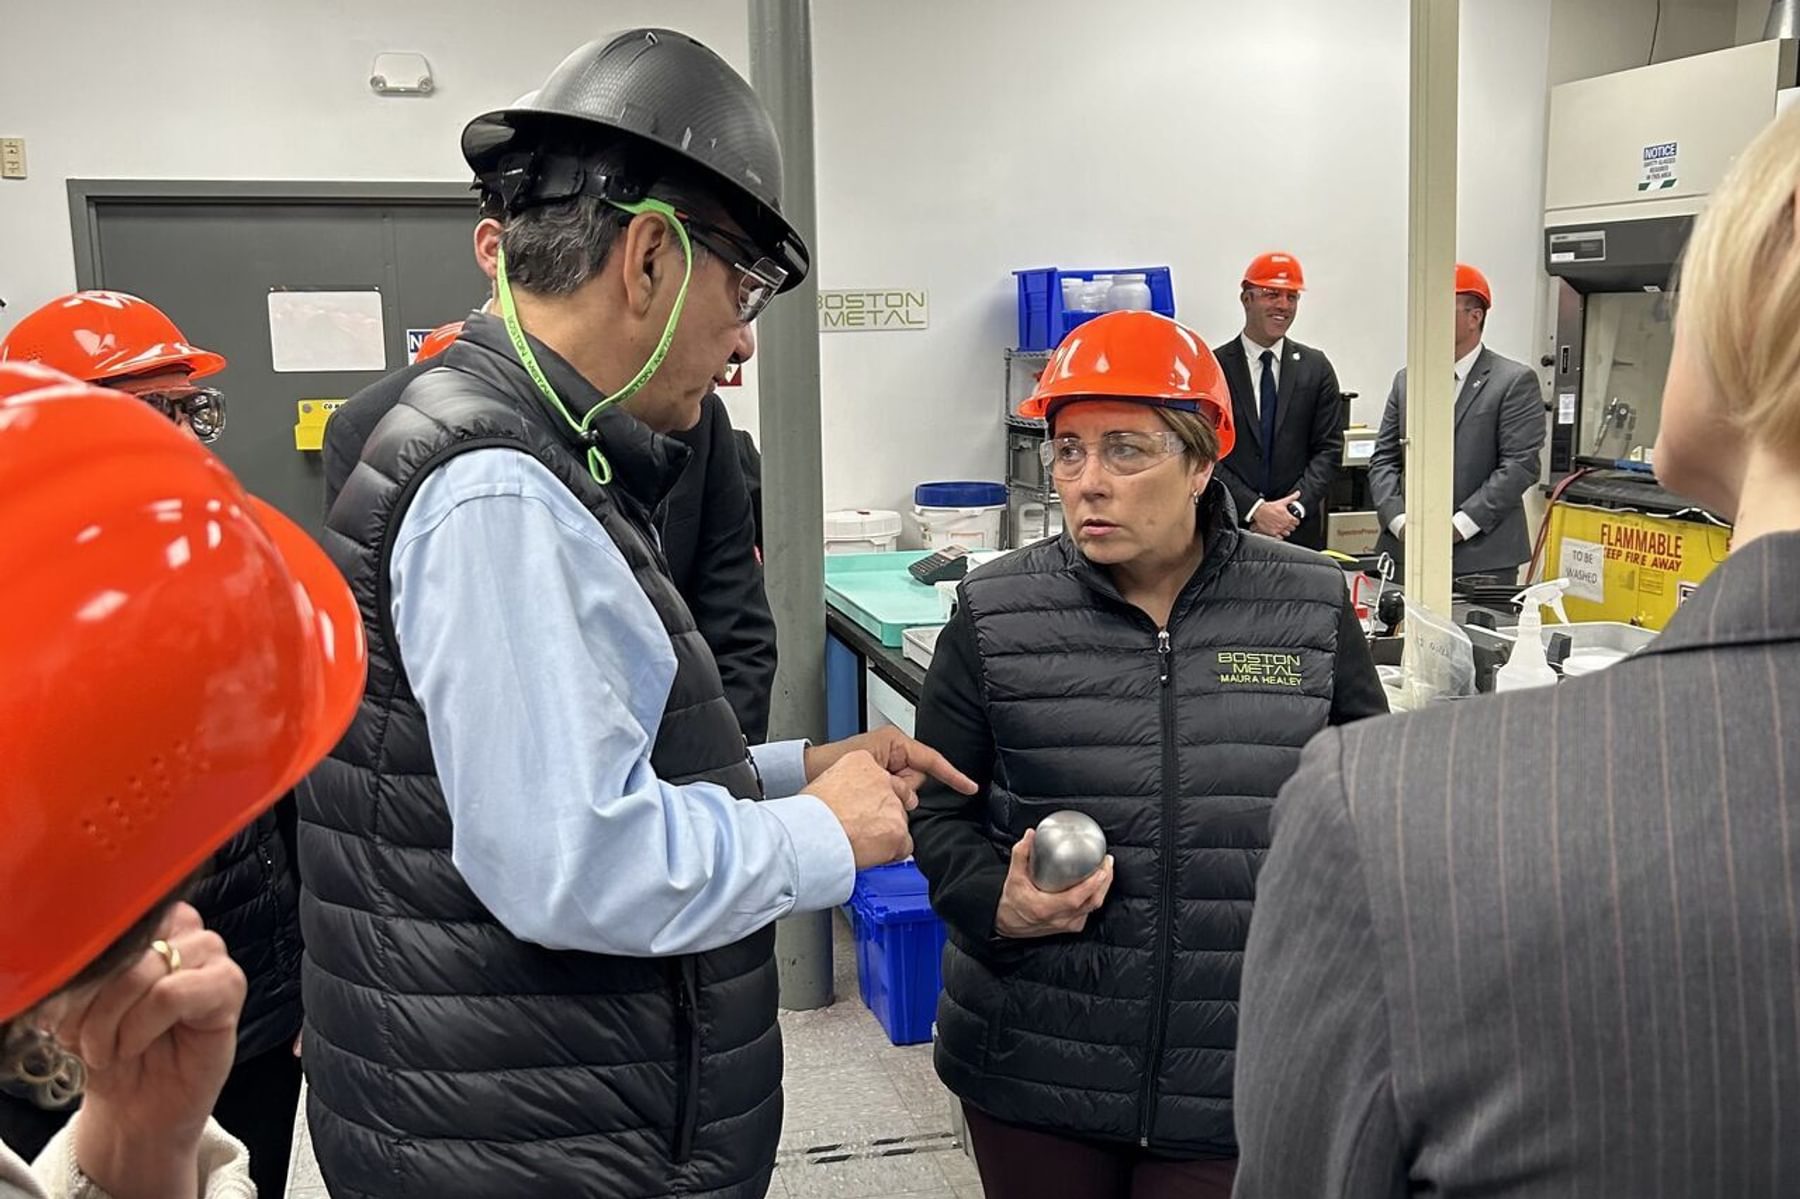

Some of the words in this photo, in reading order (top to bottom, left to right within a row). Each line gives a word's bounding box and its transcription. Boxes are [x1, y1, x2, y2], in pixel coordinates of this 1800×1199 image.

[1645, 144, 1676, 160] NOTICE
[824, 309, 925, 327] METAL
[1600, 523, 1683, 558] FLAMMABLE
[1572, 550, 1583, 562] TO
[1584, 553, 1594, 565] BE
[1625, 551, 1647, 566] FIRE
[1651, 555, 1682, 572] AWAY
[1566, 568, 1598, 584] WASHED
[1217, 652, 1301, 666] BOSTON
[1233, 664, 1302, 676] METAL
[1220, 674, 1259, 683] MAURA
[1262, 676, 1302, 686] HEALEY
